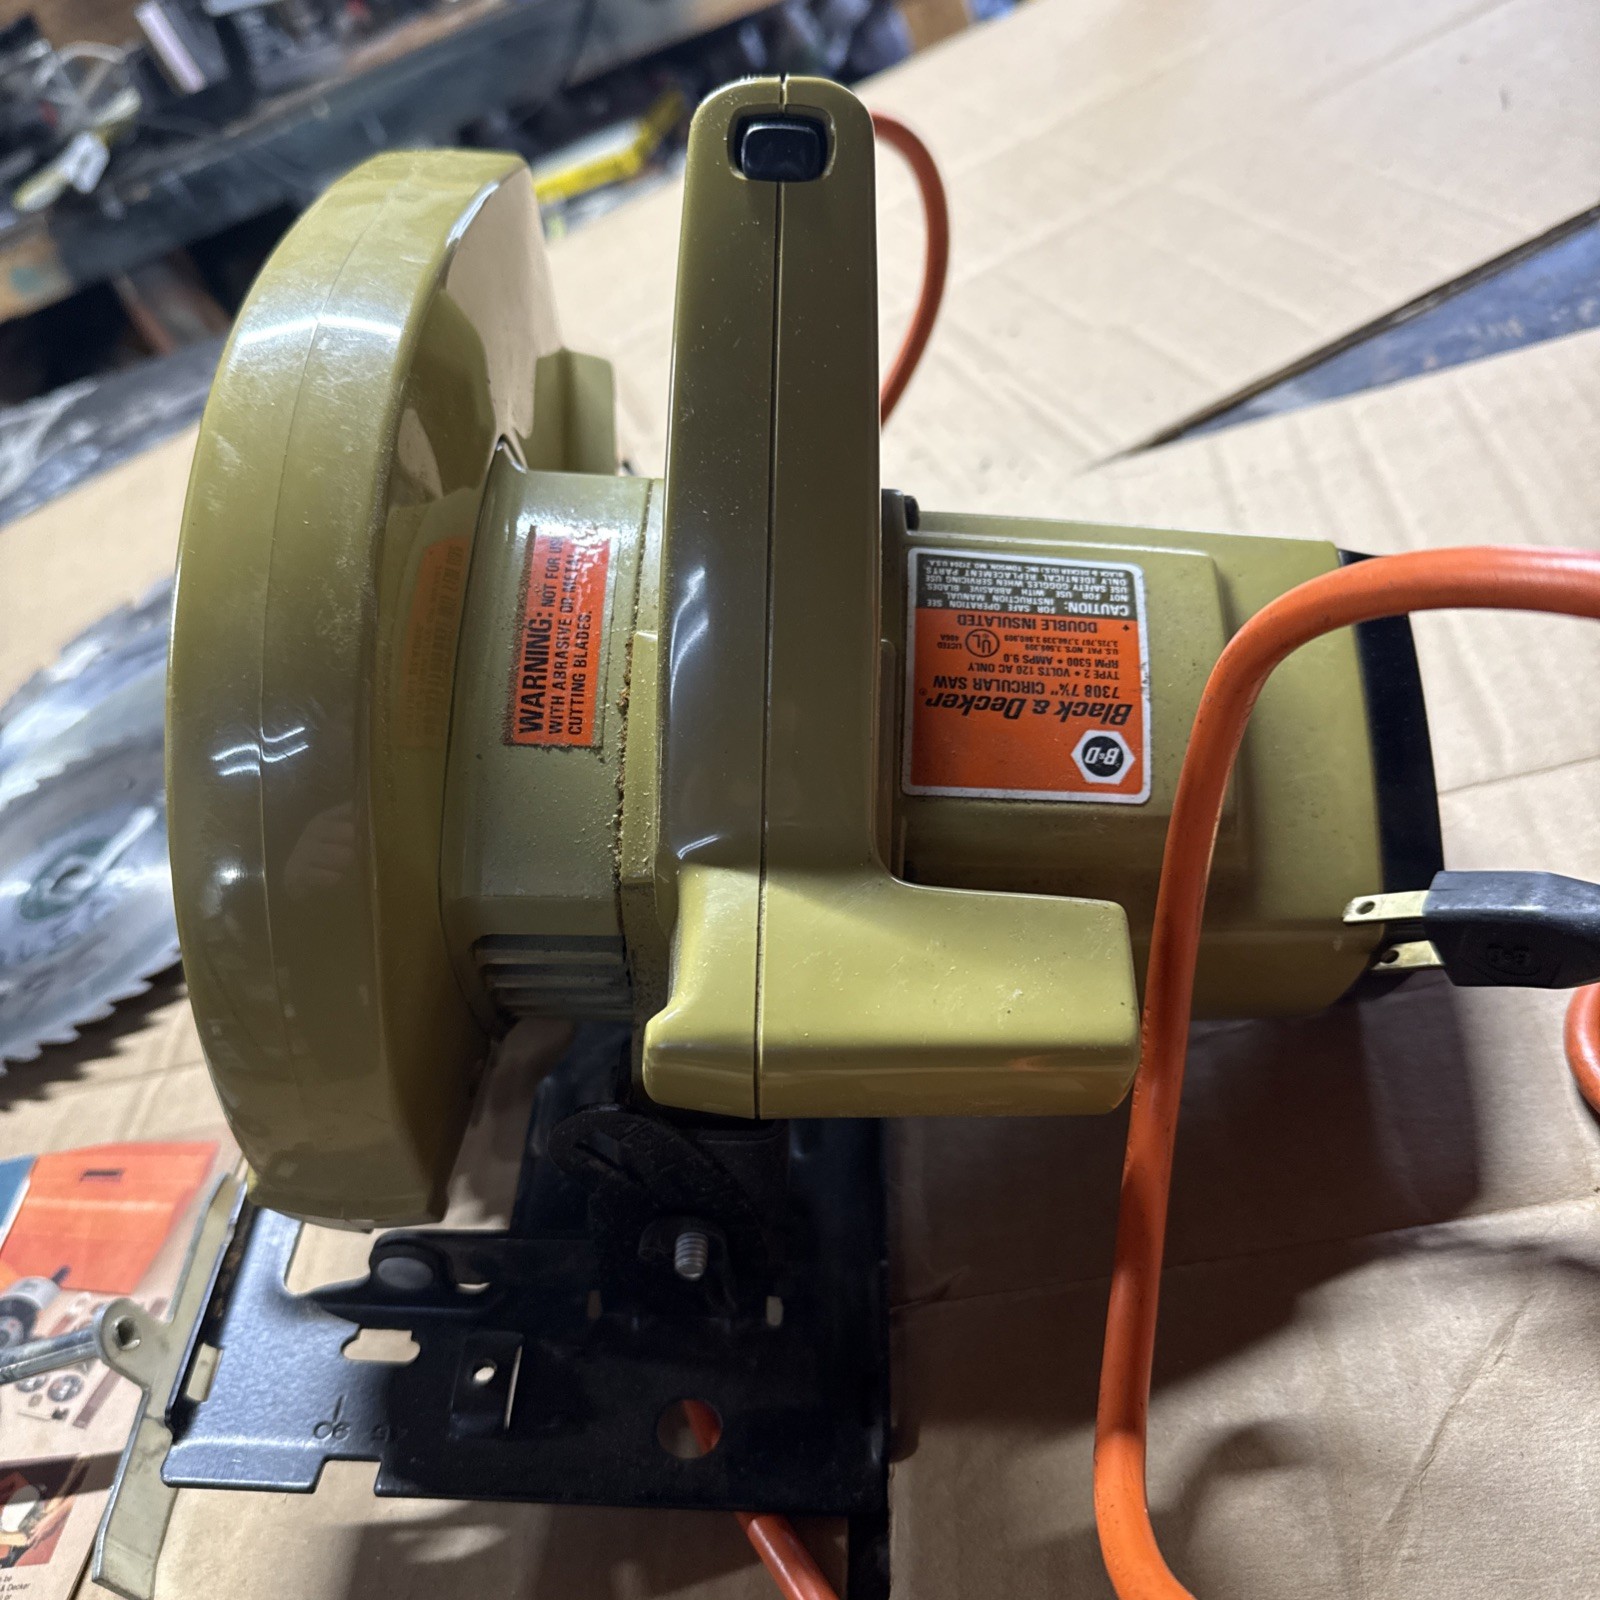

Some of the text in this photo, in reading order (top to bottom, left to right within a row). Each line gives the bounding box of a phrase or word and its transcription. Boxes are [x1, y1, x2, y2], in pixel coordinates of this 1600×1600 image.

[925, 574, 941, 582] USE
[964, 569, 1036, 579] REPLACEMENT
[1042, 574, 1095, 584] IDENTICAL
[945, 575, 992, 585] SERVICING
[996, 578, 1023, 587] WHEN
[1100, 577, 1127, 586] ONLY
[969, 585, 1011, 594] ABRASIVE
[1021, 588, 1044, 596] WITH
[1072, 583, 1107, 592] SAFETY
[1055, 590, 1072, 598] USE
[1082, 592, 1100, 600] FOR
[949, 600, 1000, 610] OPERATION
[992, 595, 1054, 605] INSTRUCTION
[560, 598, 574, 613] OR
[1007, 603, 1030, 612] SAFE
[1036, 605, 1055, 614] FOR
[1064, 601, 1129, 616] CAUTION:
[956, 614, 1097, 633] DOUBLE INSULATED
[518, 535, 562, 733] WARNING: NOT FOR US
[552, 619, 572, 690] ABRASIVE
[1002, 653, 1118, 668] RPM 5300 AMPS 9.0
[568, 611, 592, 735] CUTTING BLADES.
[968, 662, 1119, 680] TYPE 2 VOLTS 120 AC ONLY
[932, 674, 967, 690] SAW
[972, 678, 1045, 694] CIRCULAR
[1084, 684, 1119, 698] 7308
[925, 692, 1132, 725] Black & Decker
[549, 696, 565, 734] WITH
[1084, 746, 1119, 765] B&D
